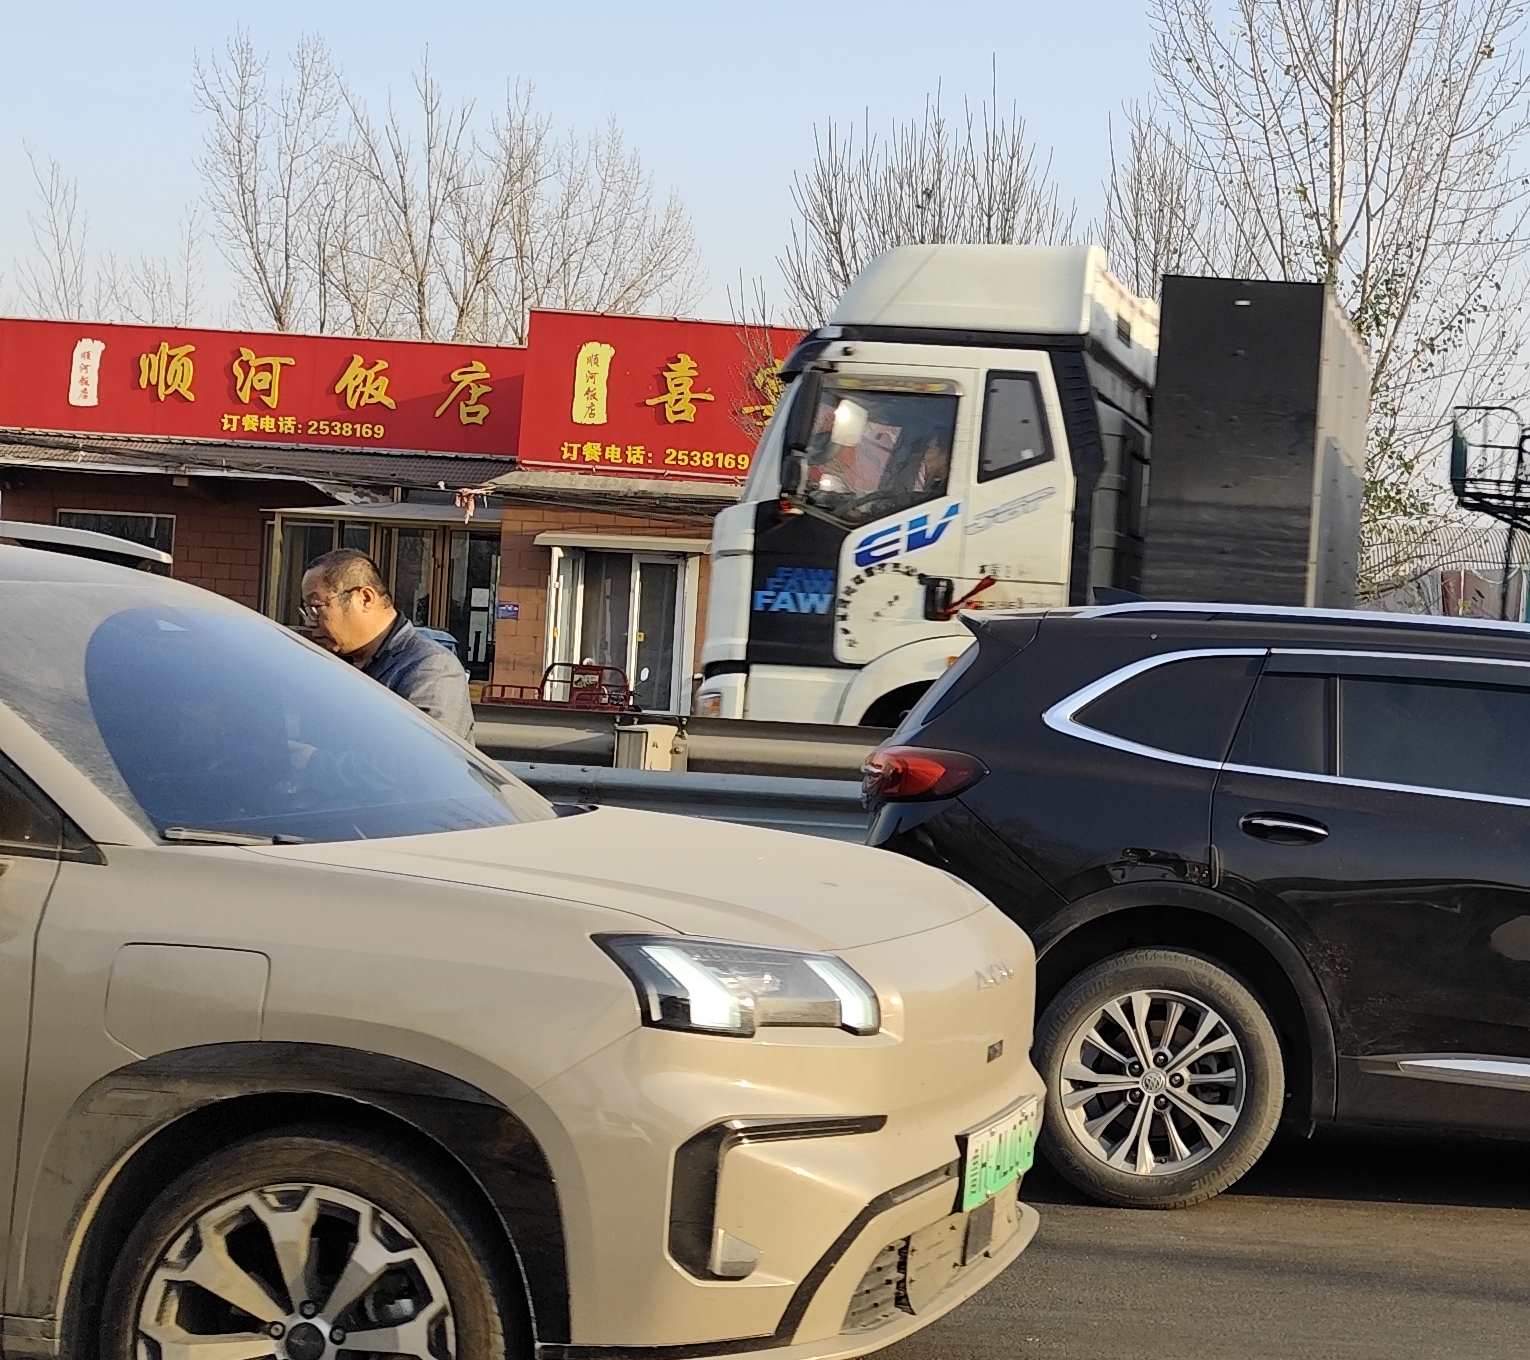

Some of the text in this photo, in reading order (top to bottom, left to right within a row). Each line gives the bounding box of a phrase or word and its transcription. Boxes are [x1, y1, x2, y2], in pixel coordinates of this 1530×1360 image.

[139, 341, 493, 426] 顺河饭店
[307, 420, 386, 439] 2538169
[664, 448, 750, 470] 2538169
[752, 590, 834, 616] FAW
